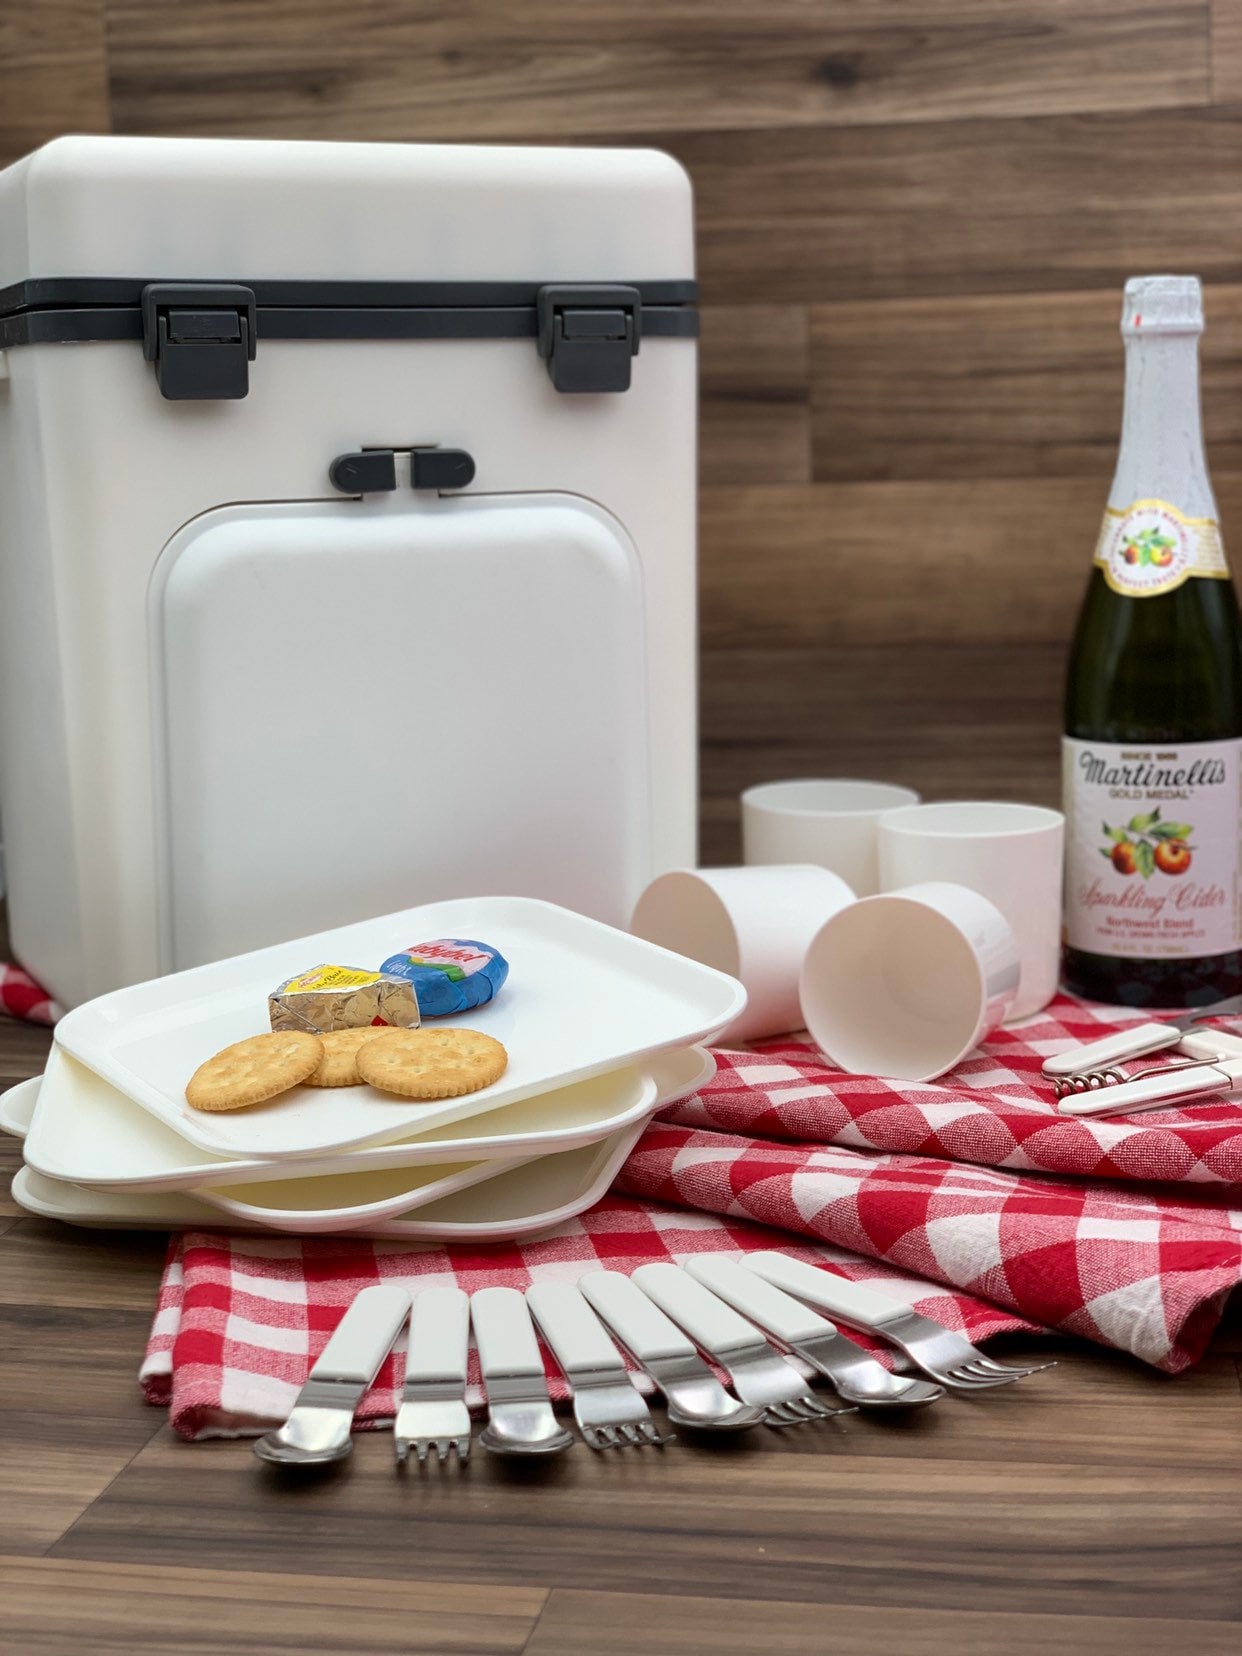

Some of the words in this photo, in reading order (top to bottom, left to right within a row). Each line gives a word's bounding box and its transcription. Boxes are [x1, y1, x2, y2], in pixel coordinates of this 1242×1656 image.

[1109, 788, 1143, 799] GOLD
[1080, 878, 1166, 917] Sparkling
[1168, 882, 1226, 911] Cider
[1163, 918, 1194, 929] Blend
